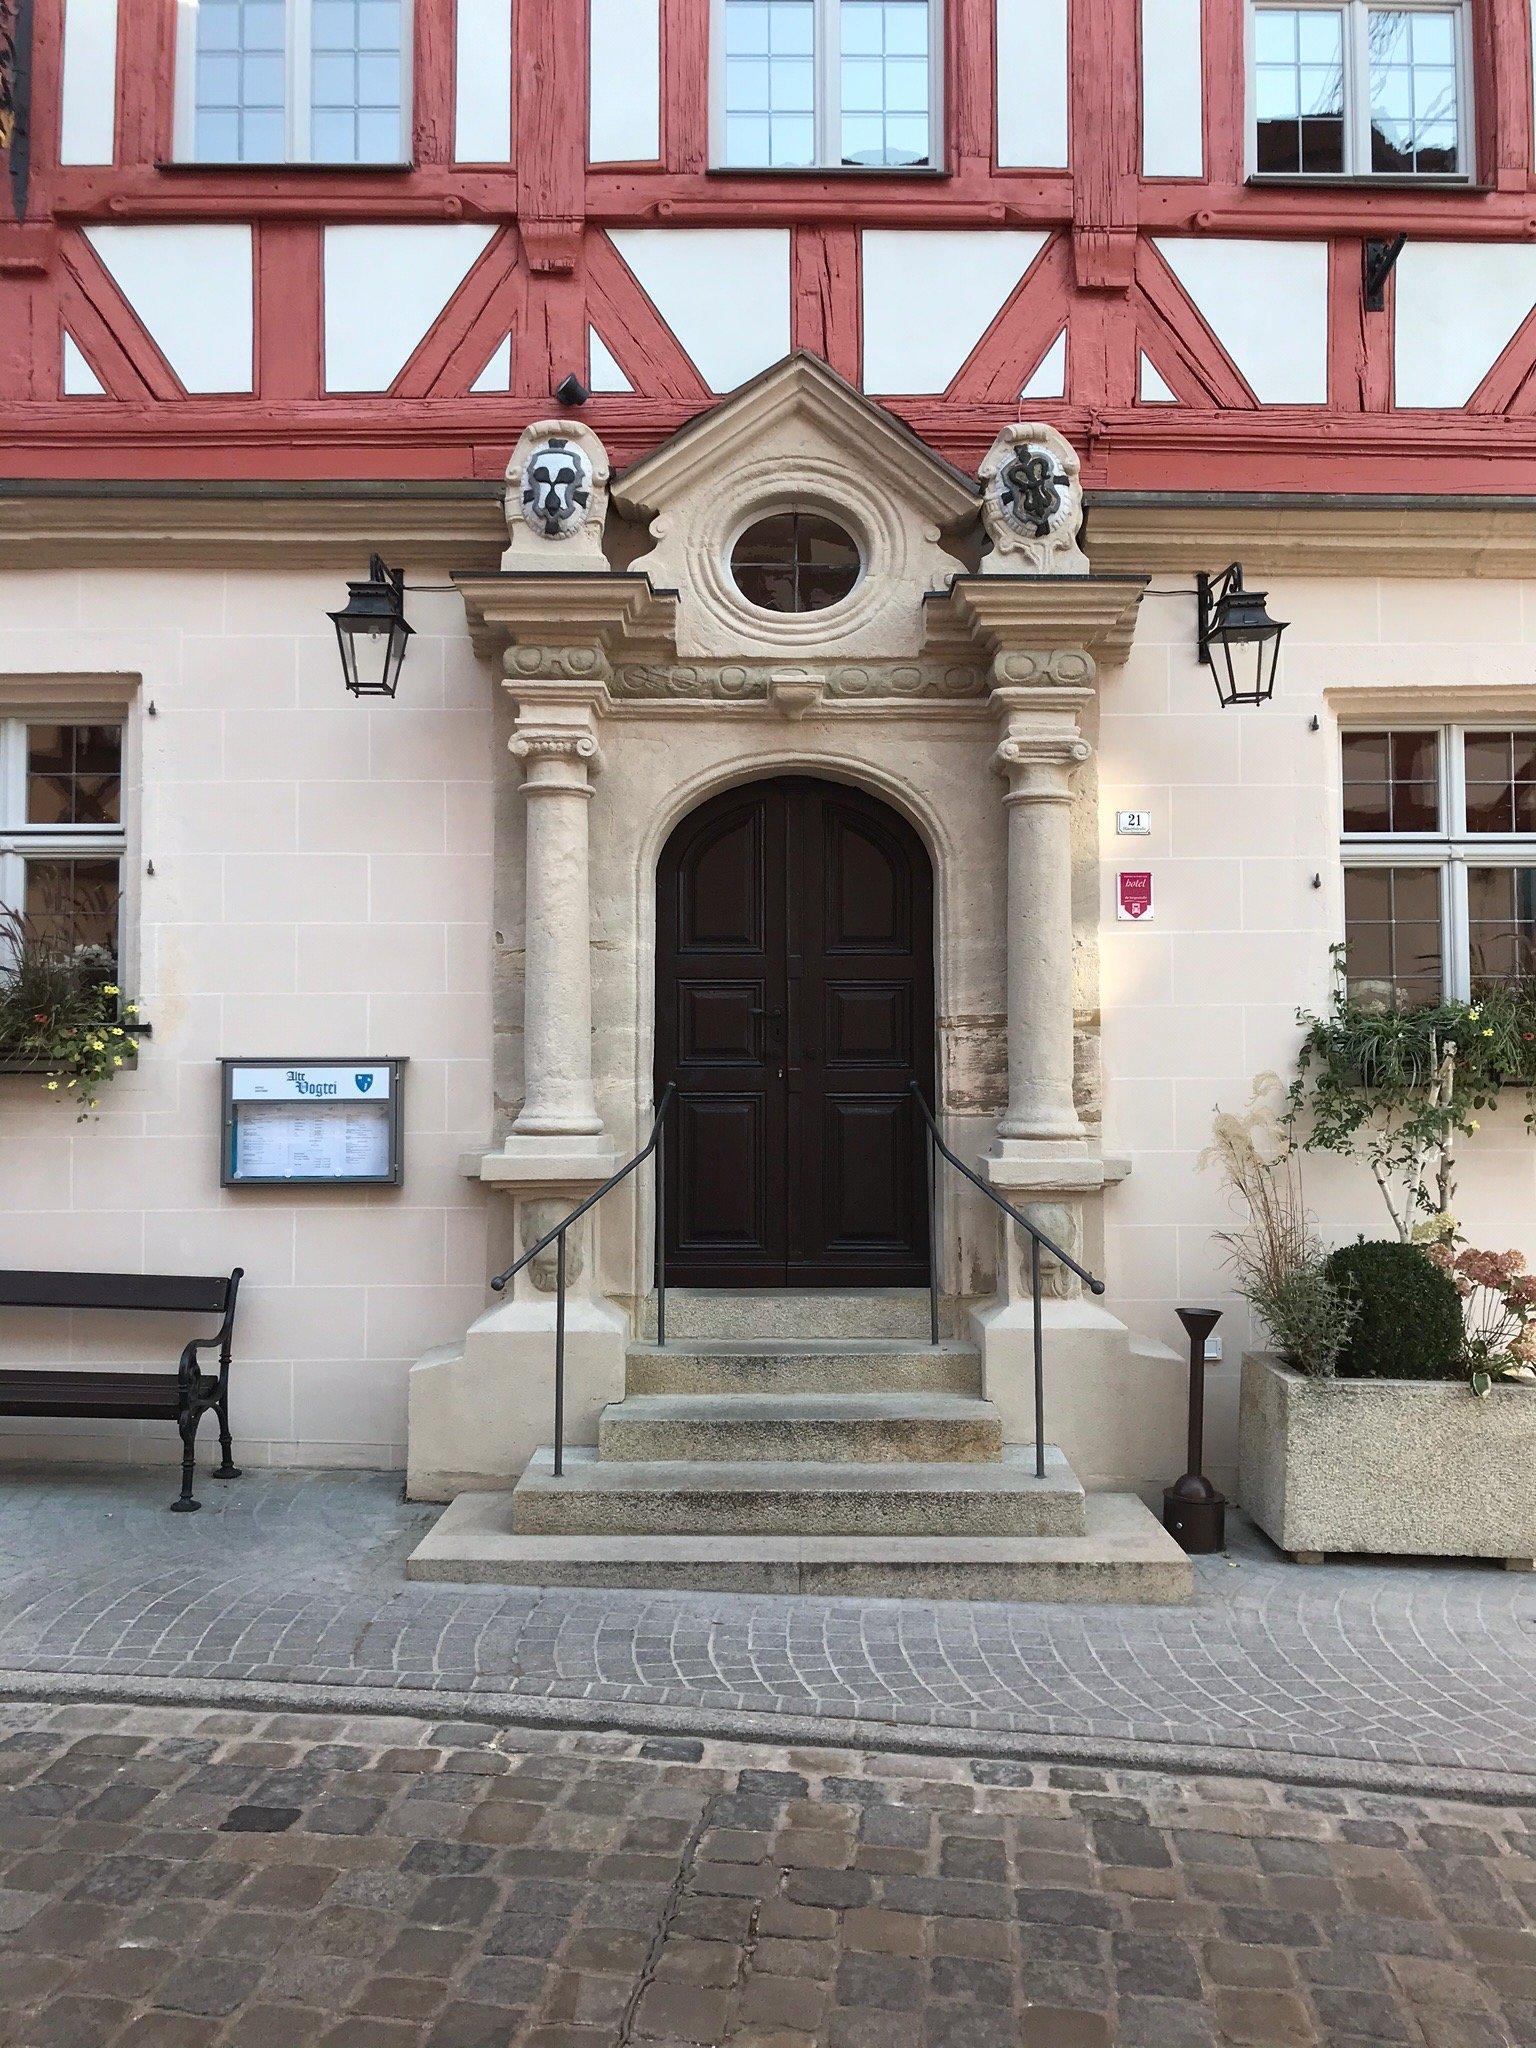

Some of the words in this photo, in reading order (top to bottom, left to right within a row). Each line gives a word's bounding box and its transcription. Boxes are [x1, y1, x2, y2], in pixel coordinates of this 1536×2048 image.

[1128, 814, 1141, 826] 21
[1125, 878, 1147, 887] hotel
[286, 1071, 305, 1081] Alte
[295, 1081, 337, 1097] Vogtei
